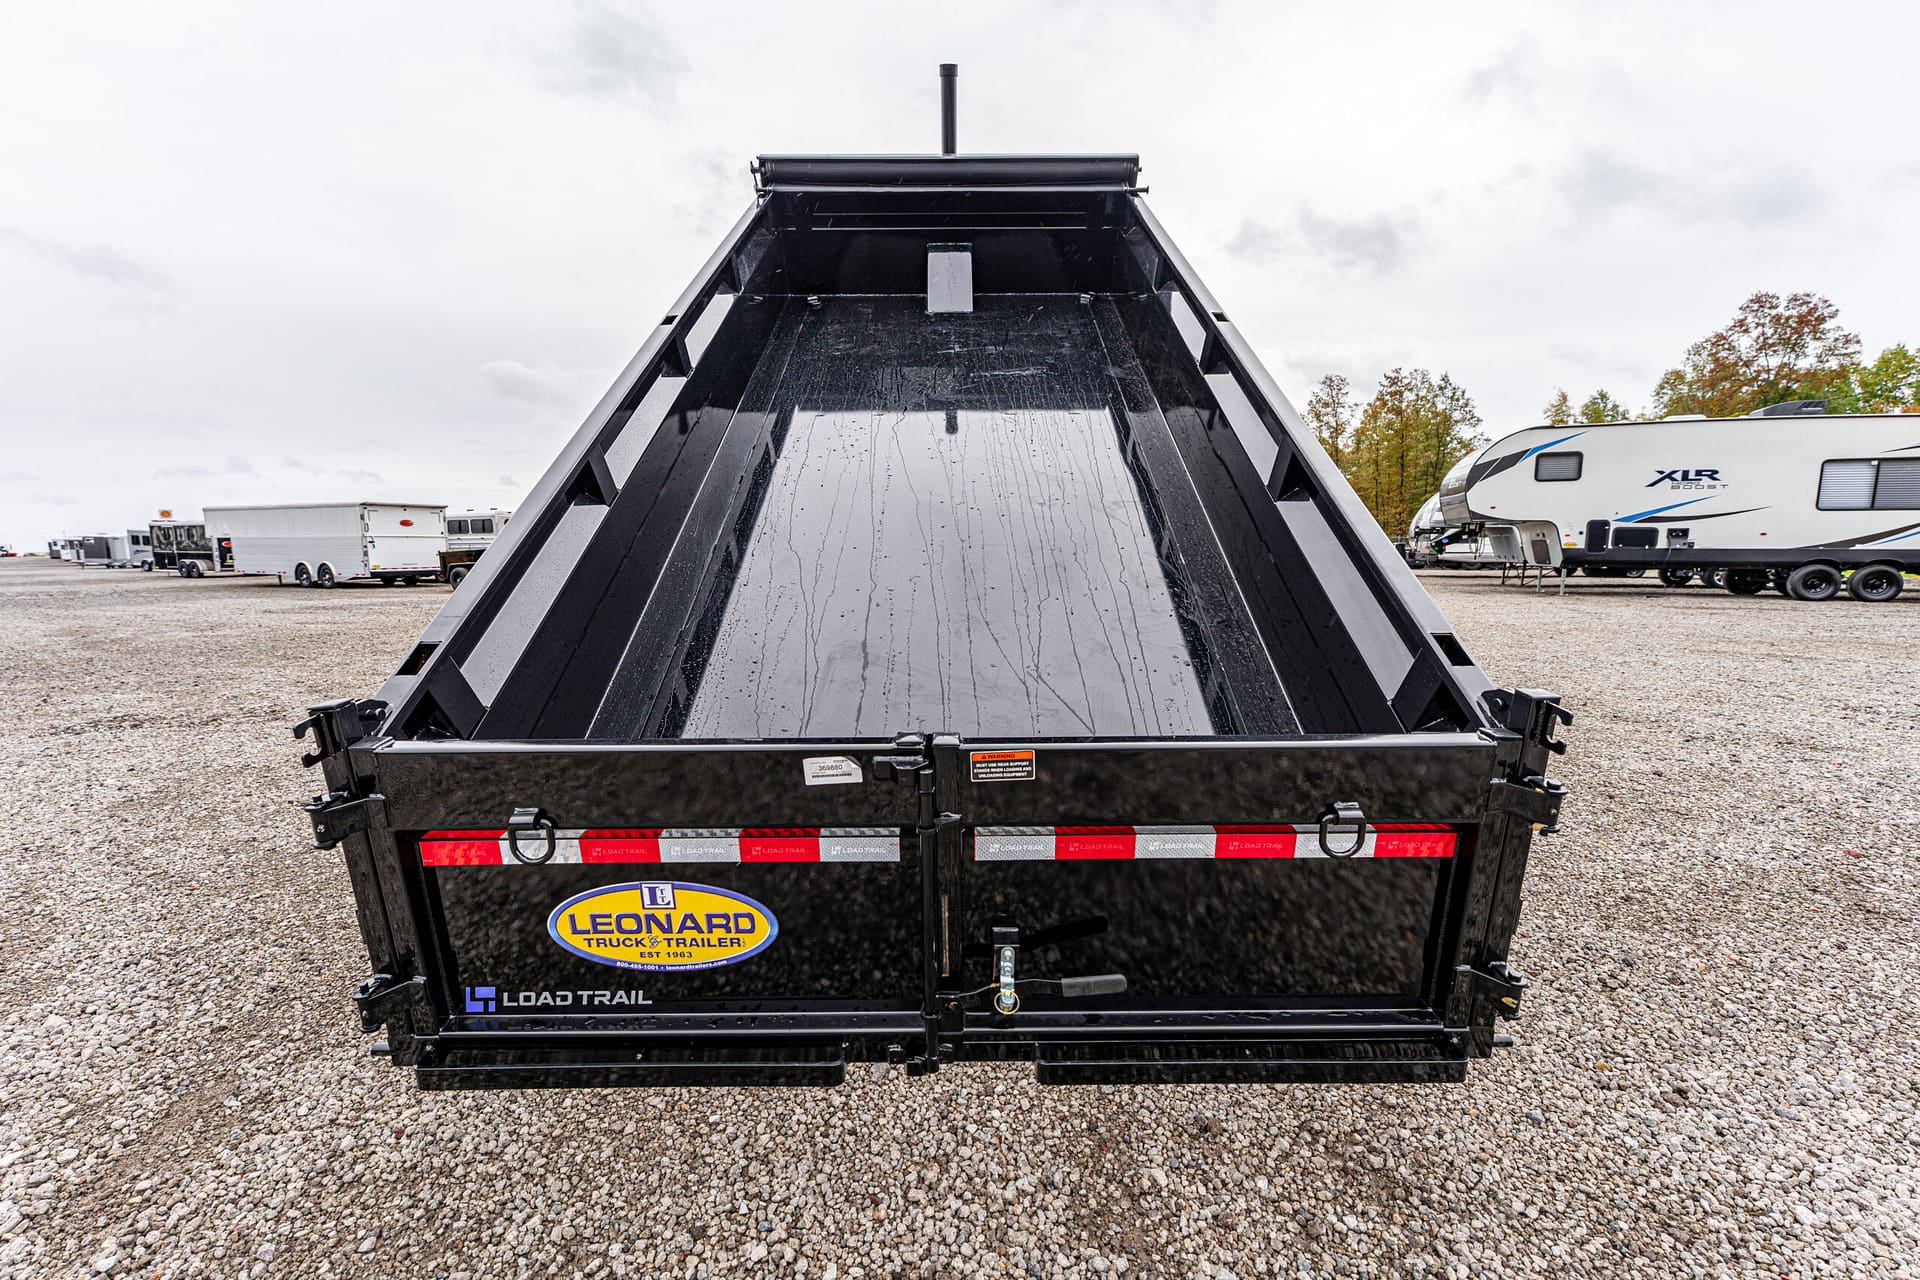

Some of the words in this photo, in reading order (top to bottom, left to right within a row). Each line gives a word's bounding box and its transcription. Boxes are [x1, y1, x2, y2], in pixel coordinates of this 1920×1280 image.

[1645, 470, 1721, 487] XLR
[568, 912, 756, 935] LEONARD
[584, 937, 646, 948] TRUCK
[663, 937, 741, 948] TRAILER
[665, 960, 728, 970] leonardtrailers.com
[503, 992, 573, 1006] LOAD
[577, 990, 653, 1005] TRAIL
